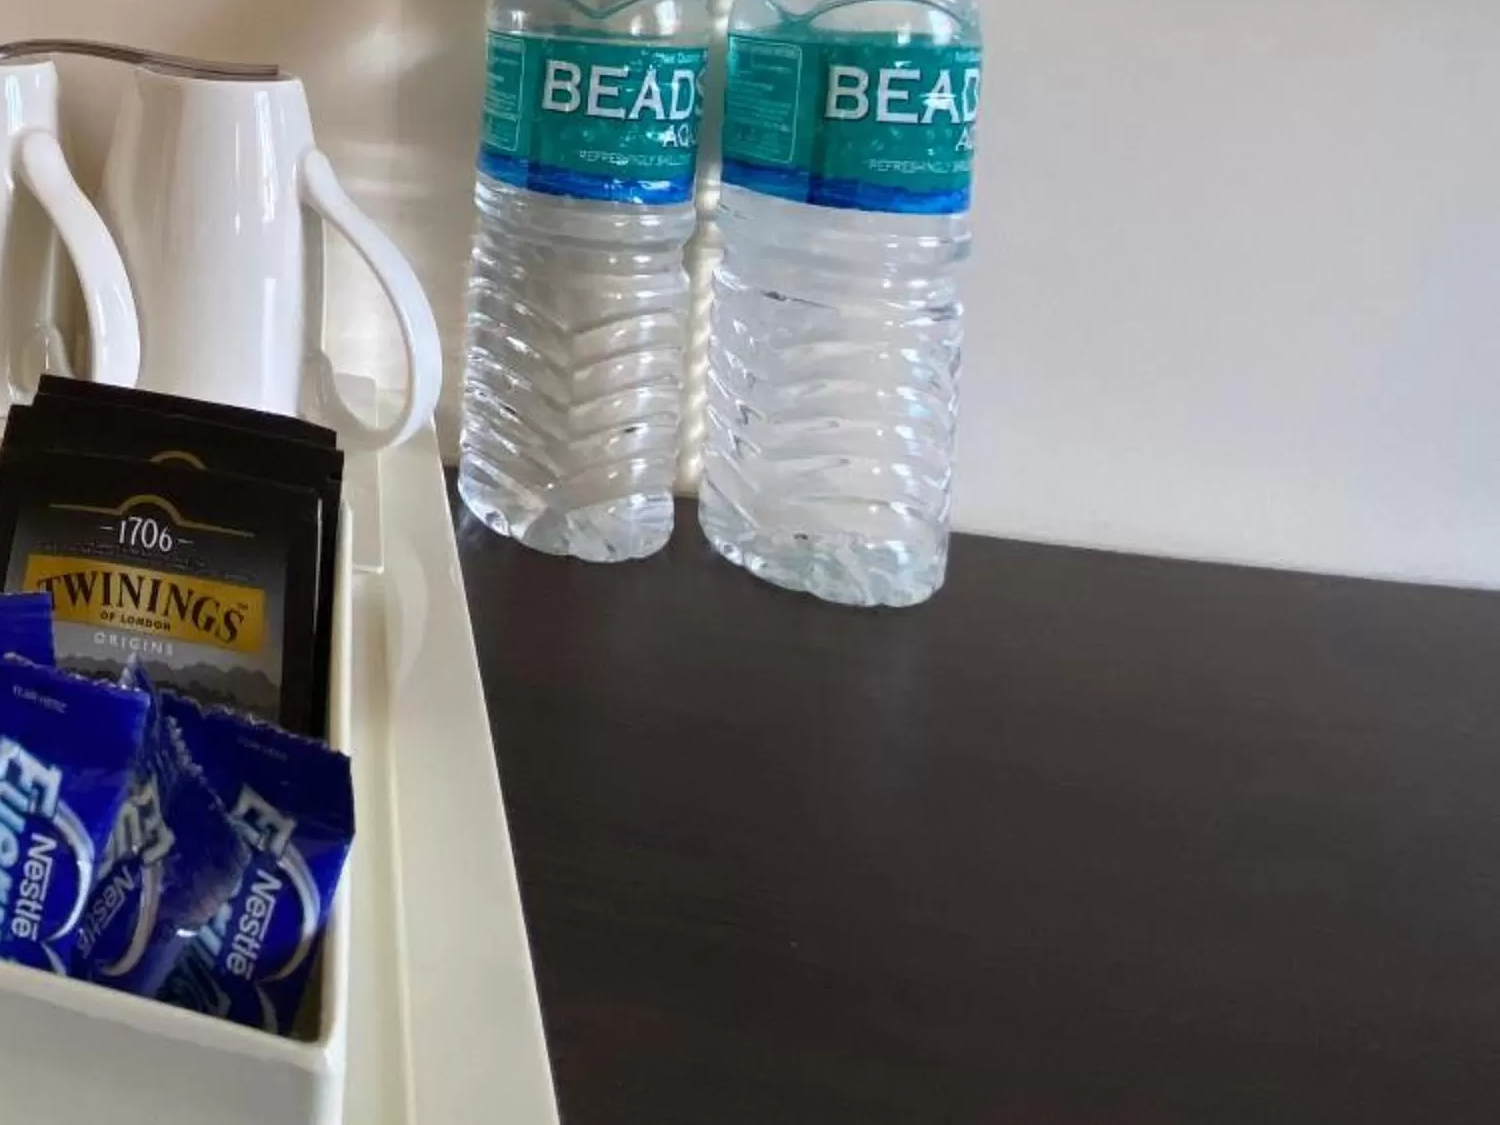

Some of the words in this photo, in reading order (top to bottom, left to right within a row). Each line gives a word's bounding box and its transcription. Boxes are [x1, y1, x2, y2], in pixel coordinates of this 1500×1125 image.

[118, 516, 173, 553] 1706
[37, 569, 246, 644] TWININGS
[100, 611, 118, 623] OF
[120, 614, 172, 632] LONDON
[93, 632, 175, 658] ORIGINS
